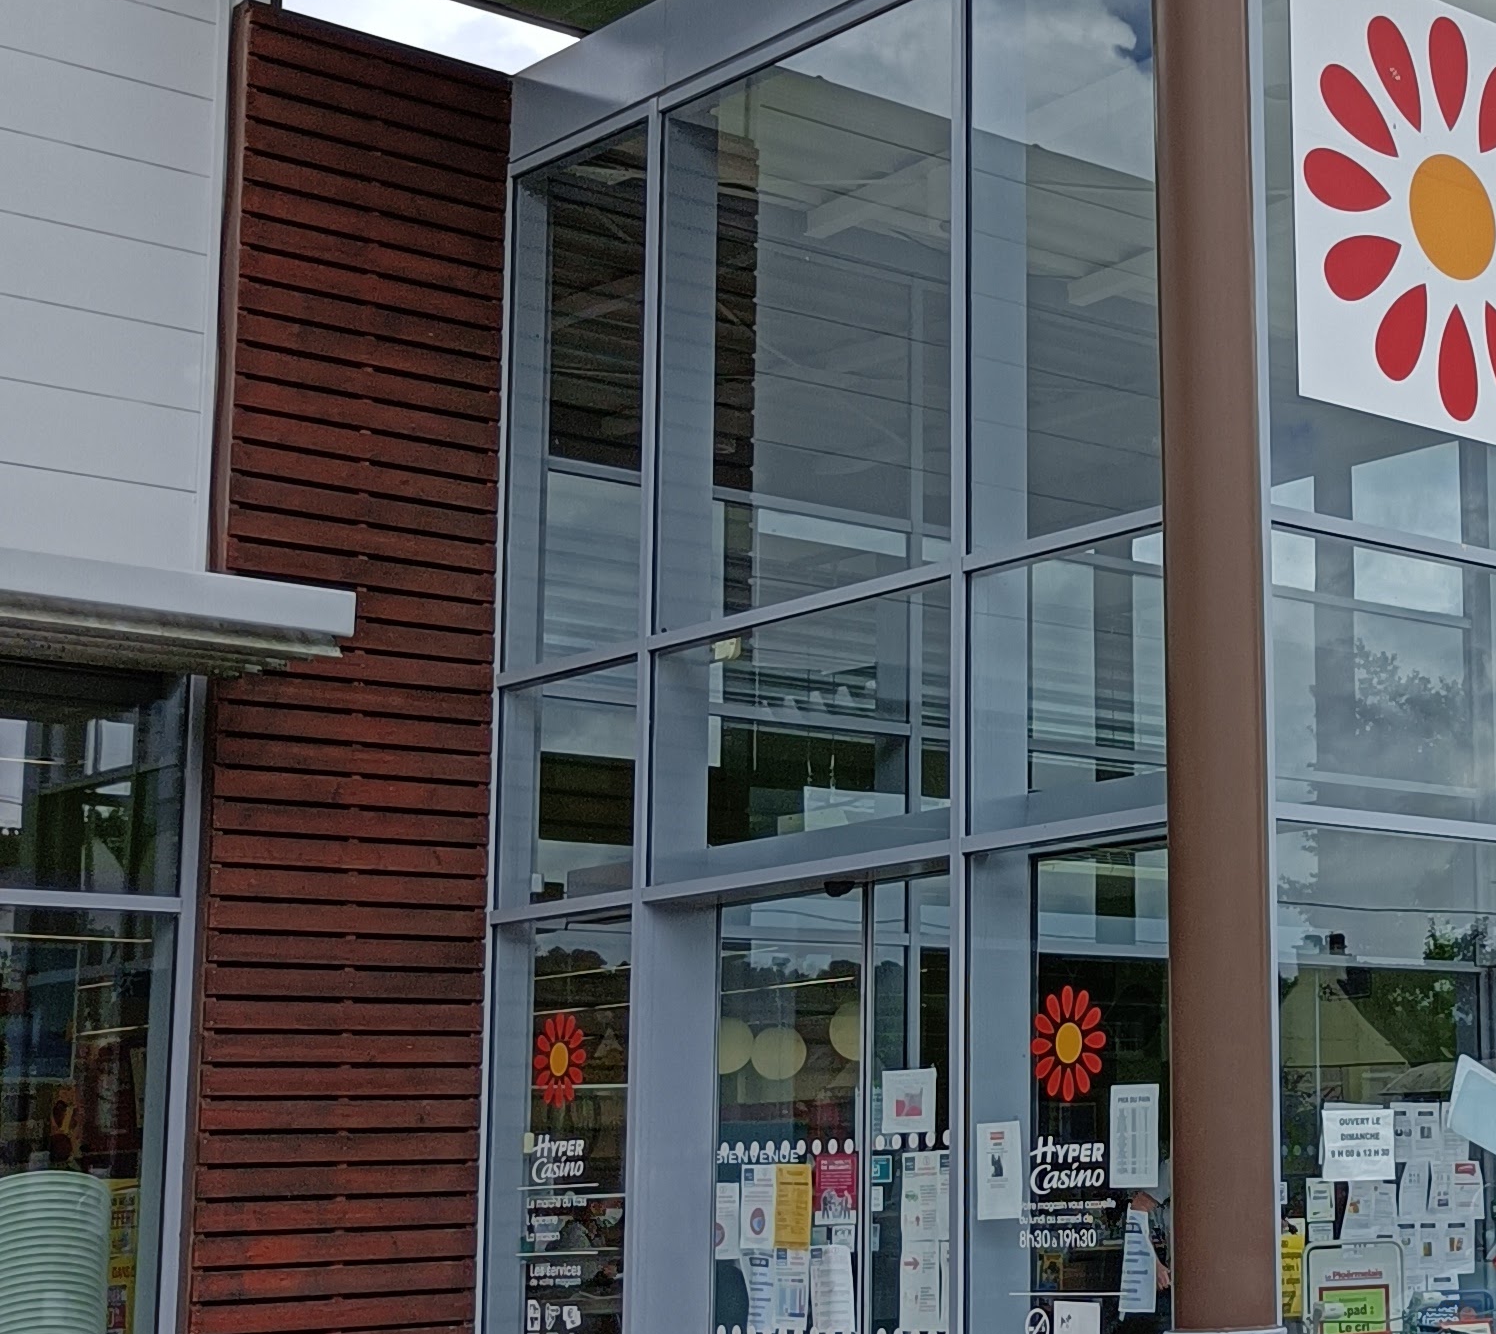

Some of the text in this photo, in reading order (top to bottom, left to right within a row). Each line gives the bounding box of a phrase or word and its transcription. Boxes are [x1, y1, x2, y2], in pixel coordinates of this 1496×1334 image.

[1339, 1117, 1381, 1126] OUVERT LE
[532, 1134, 585, 1158] HYPER
[1340, 1132, 1380, 1141] DIMANCHE
[1029, 1136, 1105, 1164] HYPER
[532, 1156, 585, 1183] Casino
[1030, 1162, 1105, 1195] Casino
[1019, 1230, 1050, 1248] 8h30
[1058, 1229, 1097, 1248] 19h30
[1338, 1322, 1353, 1334] Le
